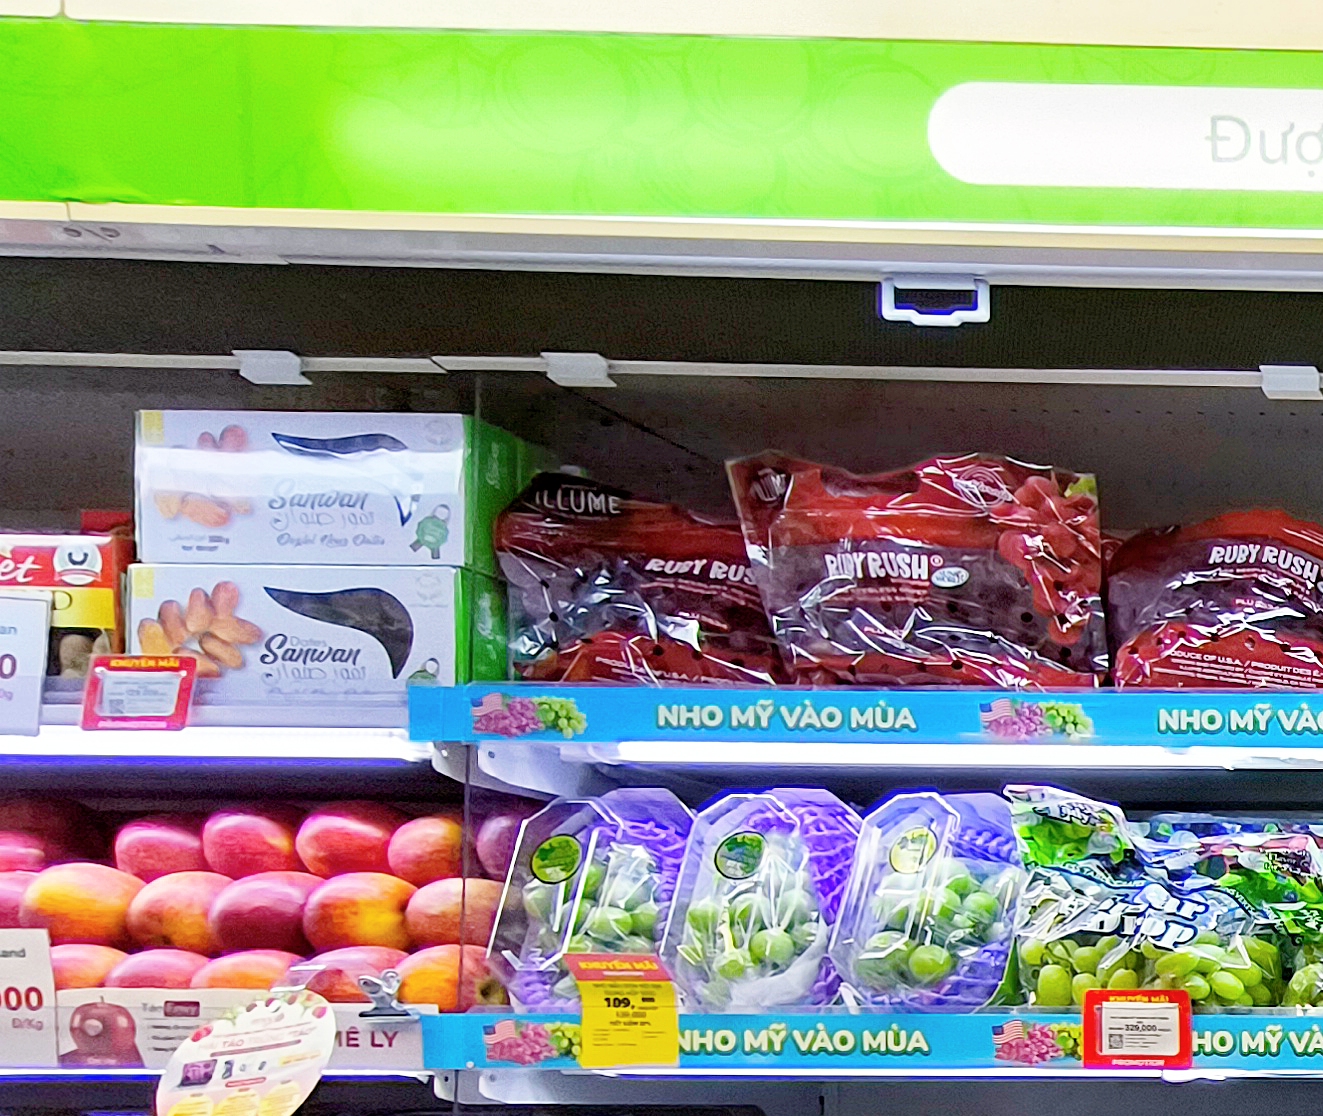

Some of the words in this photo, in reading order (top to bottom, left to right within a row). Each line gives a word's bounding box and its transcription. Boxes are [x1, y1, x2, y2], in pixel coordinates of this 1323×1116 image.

[536, 489, 621, 515] ILLUME
[1208, 544, 1261, 567] RUBY
[645, 557, 707, 576] RUBY
[709, 562, 759, 586] RUS
[259, 633, 361, 665] Sanwan
[657, 704, 723, 729] NHO
[729, 699, 775, 730] MỸ
[779, 702, 844, 731] VÀO
[849, 704, 918, 732] MÙA
[1158, 708, 1223, 733] NHO
[1228, 704, 1274, 733] MỸ
[370, 1030, 399, 1048] LY
[679, 1031, 736, 1056] NHO
[743, 1026, 787, 1056] MỸ
[792, 1024, 856, 1056] VÀO
[861, 1027, 930, 1057] MÙA
[1191, 1030, 1237, 1055] HO
[1241, 1024, 1283, 1056] MỸ
